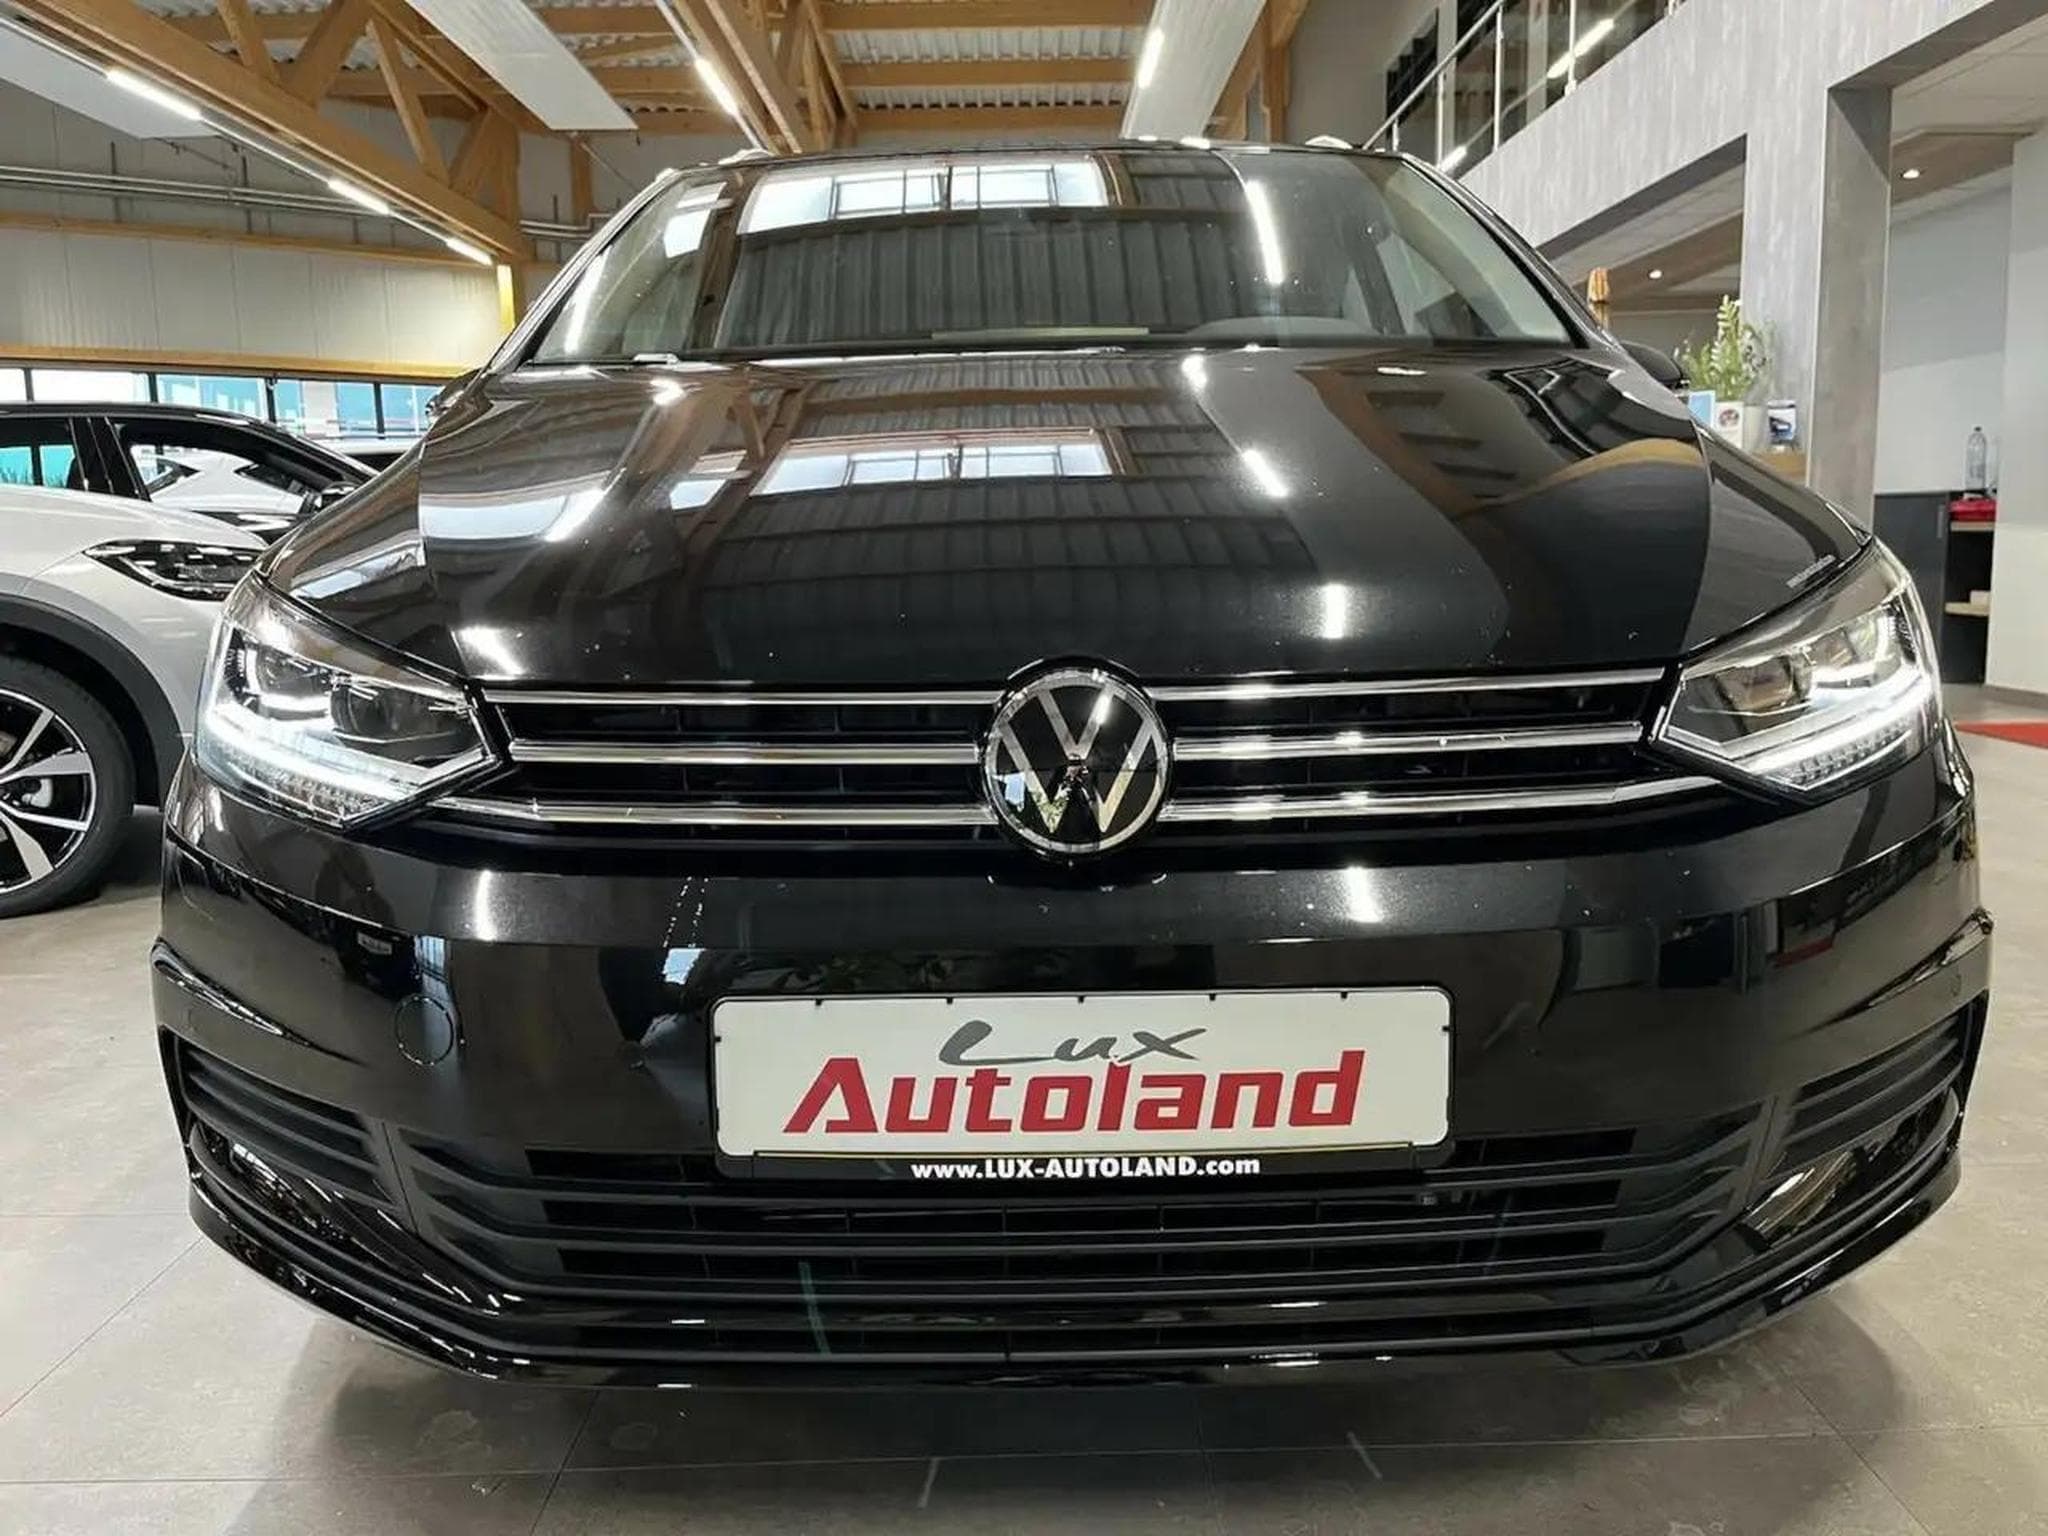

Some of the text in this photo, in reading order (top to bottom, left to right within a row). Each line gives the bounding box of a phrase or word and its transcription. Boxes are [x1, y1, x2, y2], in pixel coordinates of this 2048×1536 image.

[938, 1019, 1207, 1066] Lux
[782, 1049, 1365, 1133] Autoland
[910, 1156, 1262, 1180] www.LUX-AUTOLAND.com
